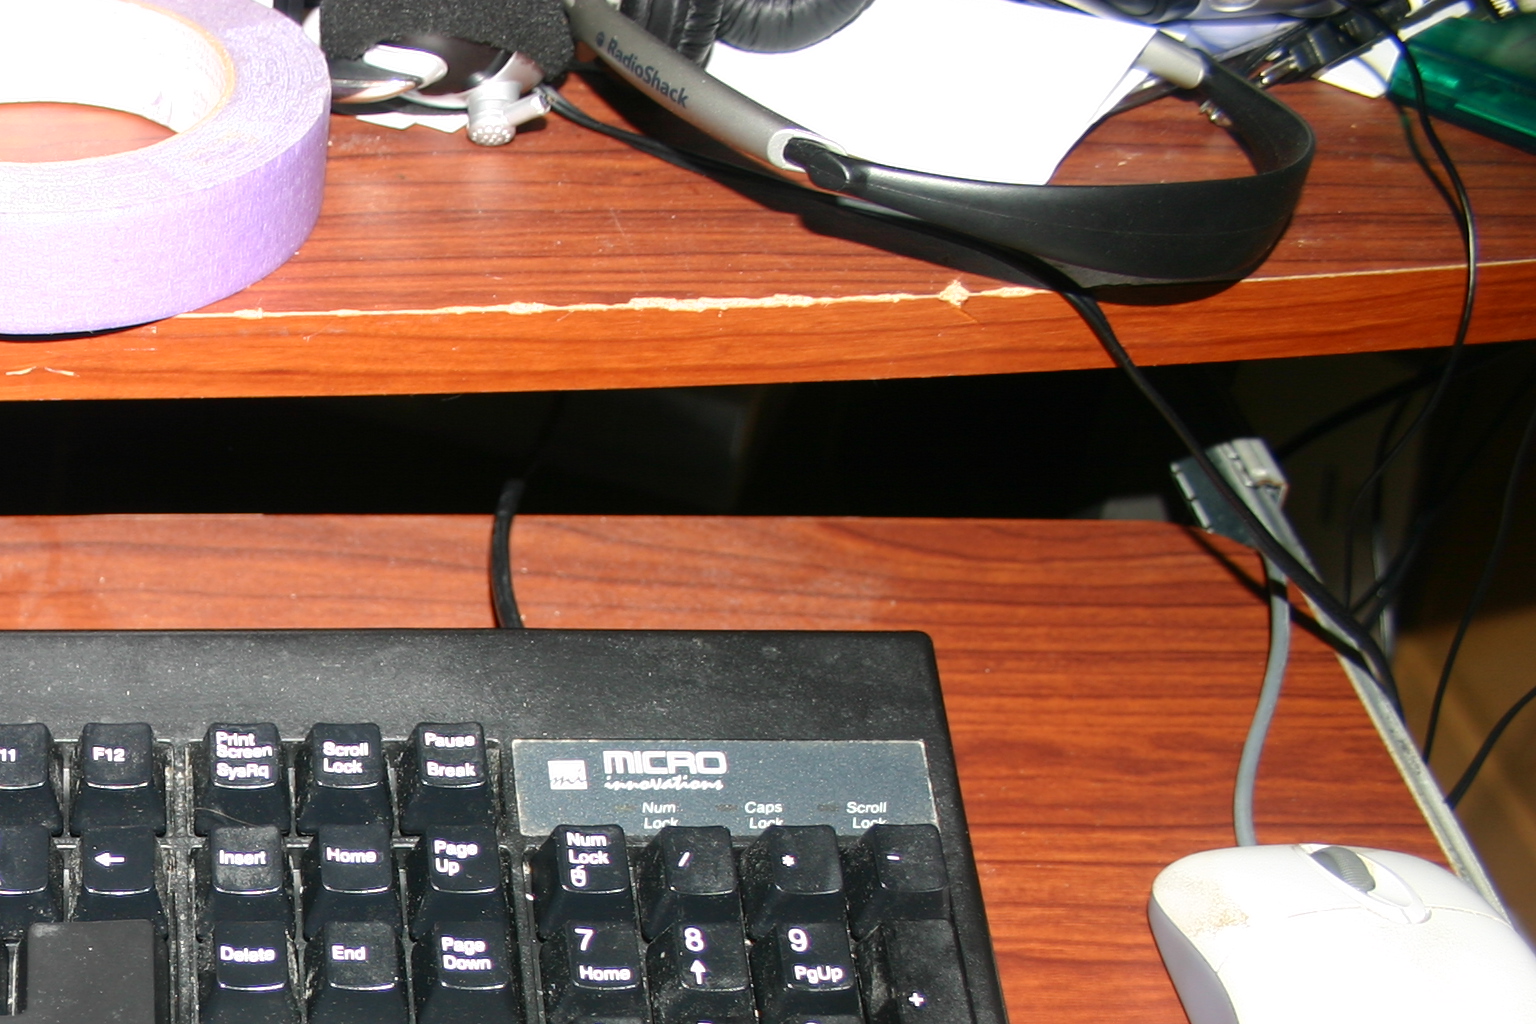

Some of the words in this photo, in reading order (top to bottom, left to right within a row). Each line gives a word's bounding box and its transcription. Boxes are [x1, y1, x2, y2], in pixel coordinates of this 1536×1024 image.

[606, 34, 691, 110] RadioShack
[215, 731, 257, 747] Print
[424, 731, 479, 750] Pause
[92, 746, 126, 763] F12
[215, 745, 274, 760] Screen
[322, 740, 370, 758] Scroll
[215, 762, 271, 780] SysRq
[322, 757, 364, 775] Lock
[426, 760, 477, 778] Break
[602, 751, 728, 775] MICRO
[604, 776, 725, 791] innovations
[642, 802, 677, 814] Num
[744, 801, 784, 815] Caps
[846, 801, 888, 814] Scroll
[565, 831, 608, 848] Num
[217, 849, 267, 866] Insert
[326, 846, 378, 864] Home
[433, 839, 479, 859] Page
[567, 848, 610, 865] Lock
[434, 858, 462, 877] Up
[440, 936, 487, 956] Page
[574, 927, 595, 952] 7
[684, 927, 705, 952] 8
[787, 928, 809, 953] 9
[219, 945, 277, 963] Delete
[331, 944, 367, 961] End
[441, 955, 493, 972] Down
[578, 964, 632, 982] Home
[793, 965, 844, 985] PgUp
